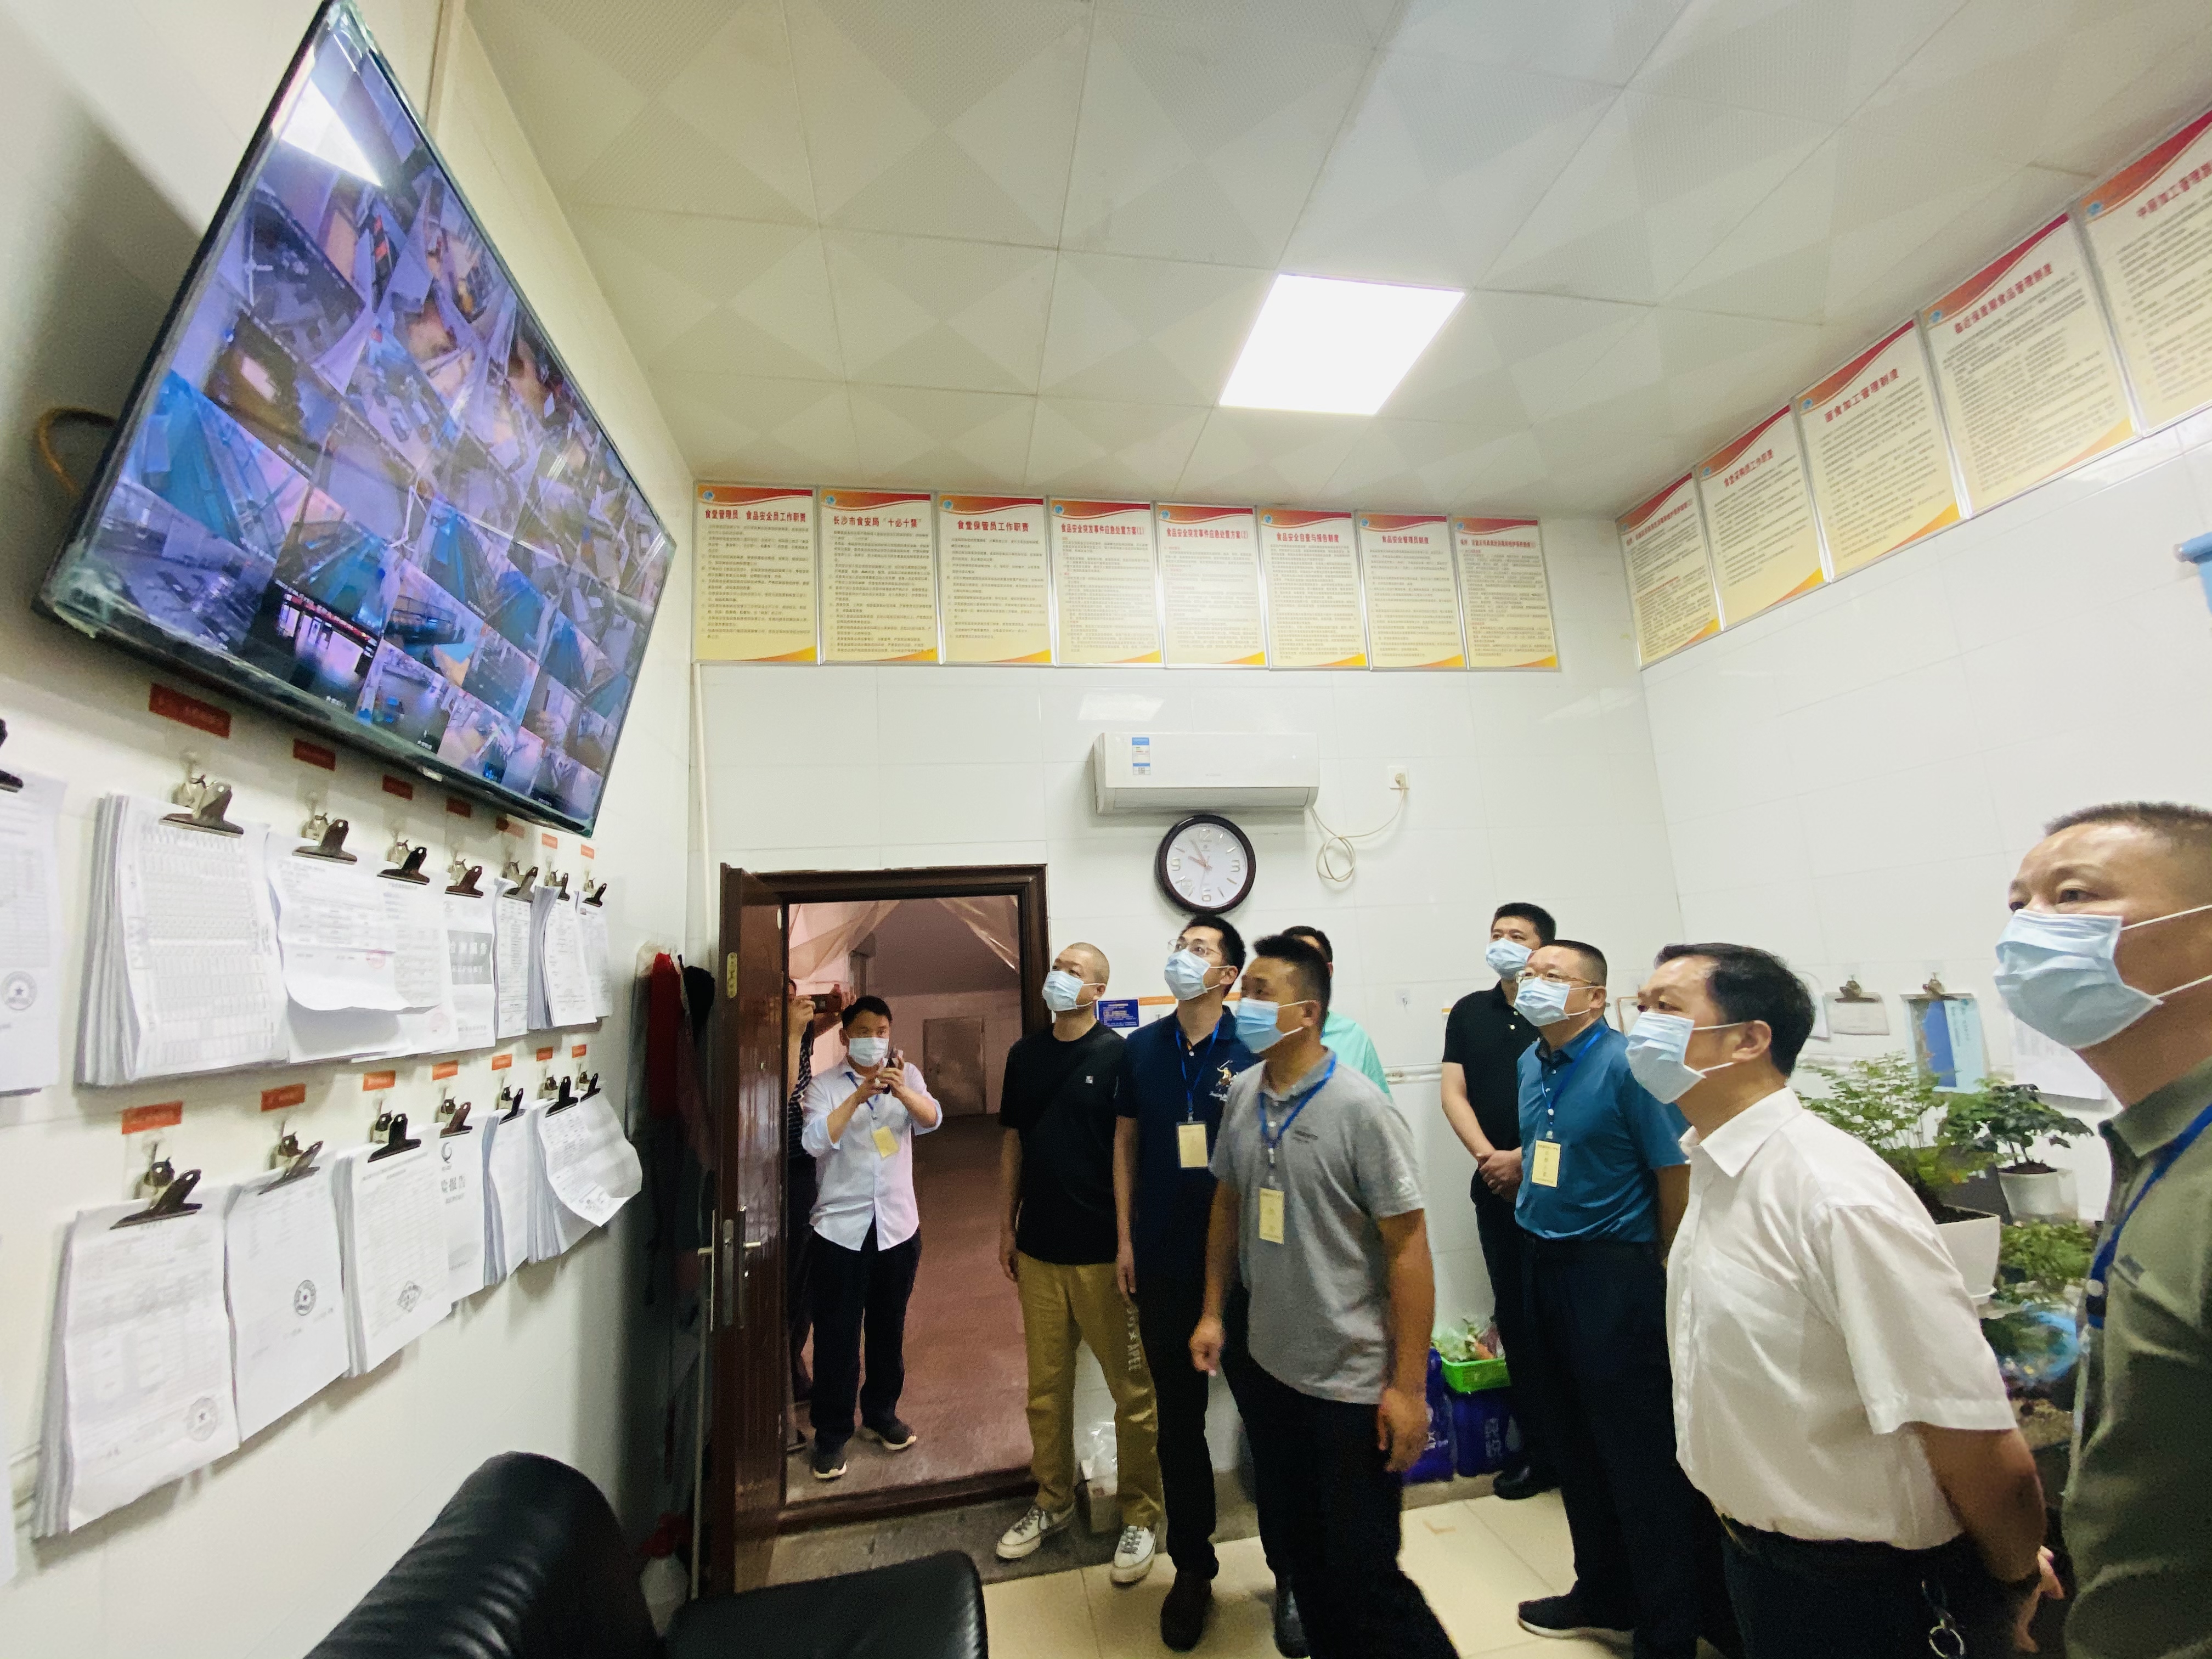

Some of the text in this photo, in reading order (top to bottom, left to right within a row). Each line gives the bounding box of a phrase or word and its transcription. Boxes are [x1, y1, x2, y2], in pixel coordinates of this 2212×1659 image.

[957, 520, 1030, 532] 食堂保管员工作职责
[1276, 532, 1339, 543] 食品安全自查与报告制度
[1170, 857, 1181, 871] 9
[1231, 859, 1240, 872] 3
[1201, 888, 1211, 902] 6
